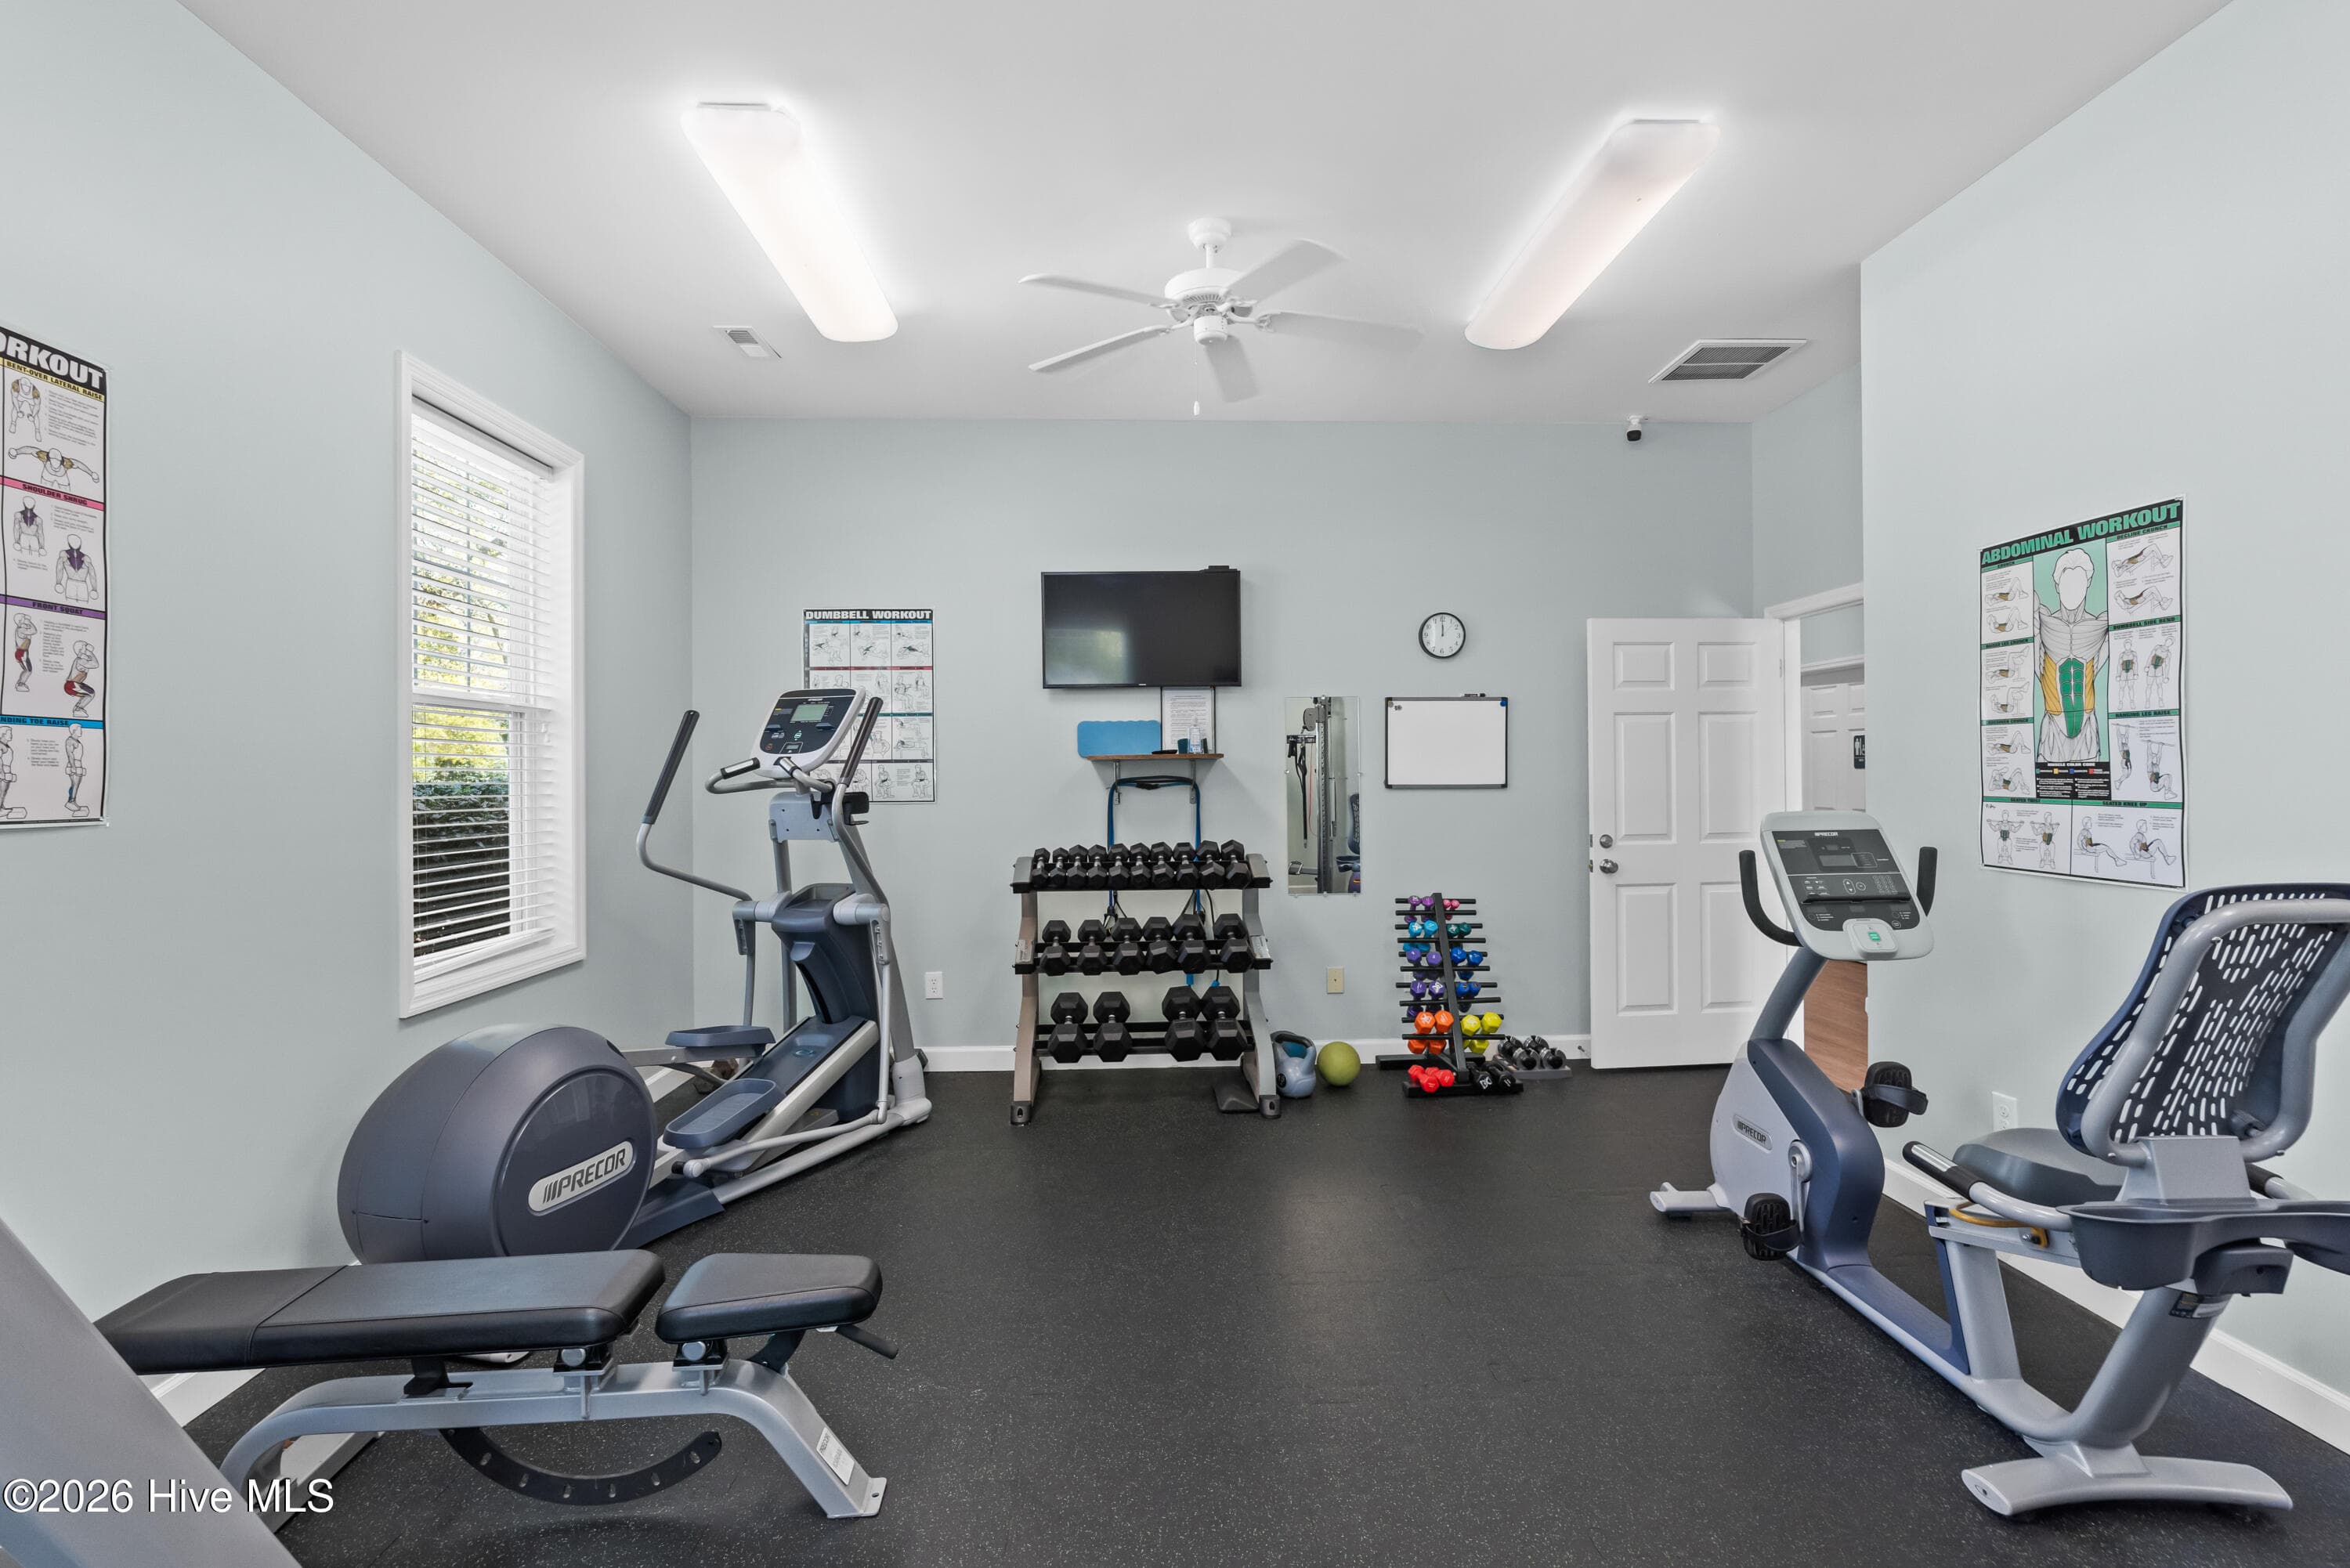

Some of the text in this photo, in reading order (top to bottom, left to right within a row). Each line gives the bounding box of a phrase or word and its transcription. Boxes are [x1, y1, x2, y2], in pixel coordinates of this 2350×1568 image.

[6, 360, 103, 399] BENT-OVER LATERAL RAISE
[22, 483, 61, 498] SHOULDER
[1982, 502, 2181, 565] ABDOMINAL WORKOUT
[32, 601, 83, 616] FRONT SQUAT
[805, 611, 931, 620] DUMBBELL WORKOUT
[1739, 1121, 1766, 1144] PRECOR
[551, 1148, 626, 1201] PRECOR
